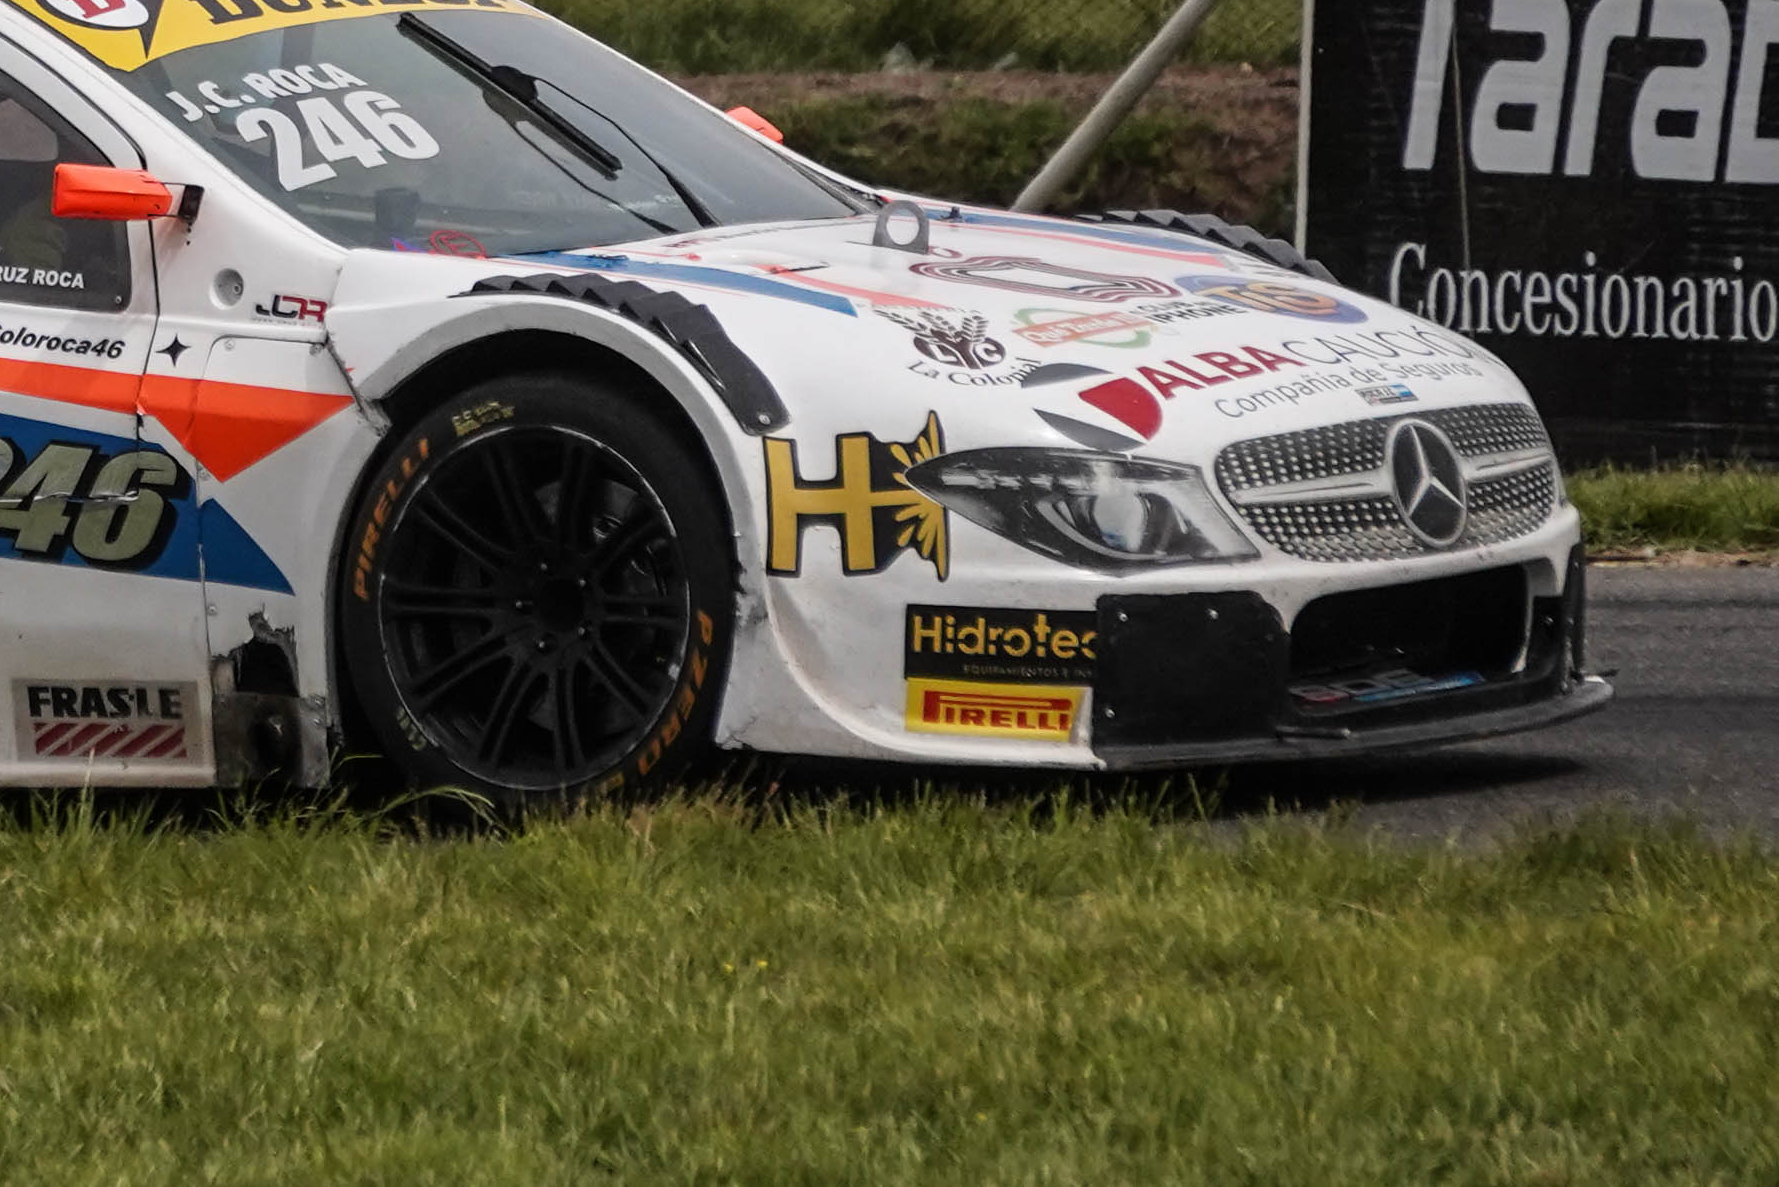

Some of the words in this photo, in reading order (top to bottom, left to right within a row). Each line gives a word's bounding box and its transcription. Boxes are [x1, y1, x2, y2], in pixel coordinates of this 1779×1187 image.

[249, 63, 367, 99] ROCA
[236, 90, 441, 192] 246
[33, 269, 85, 289] ROCA
[907, 361, 940, 379] La
[948, 357, 1041, 387] Colonial
[1136, 345, 1303, 401] ALBA
[1350, 367, 1388, 384] de
[1389, 362, 1482, 382] Seguros
[923, 690, 1072, 730] PIRELLI
